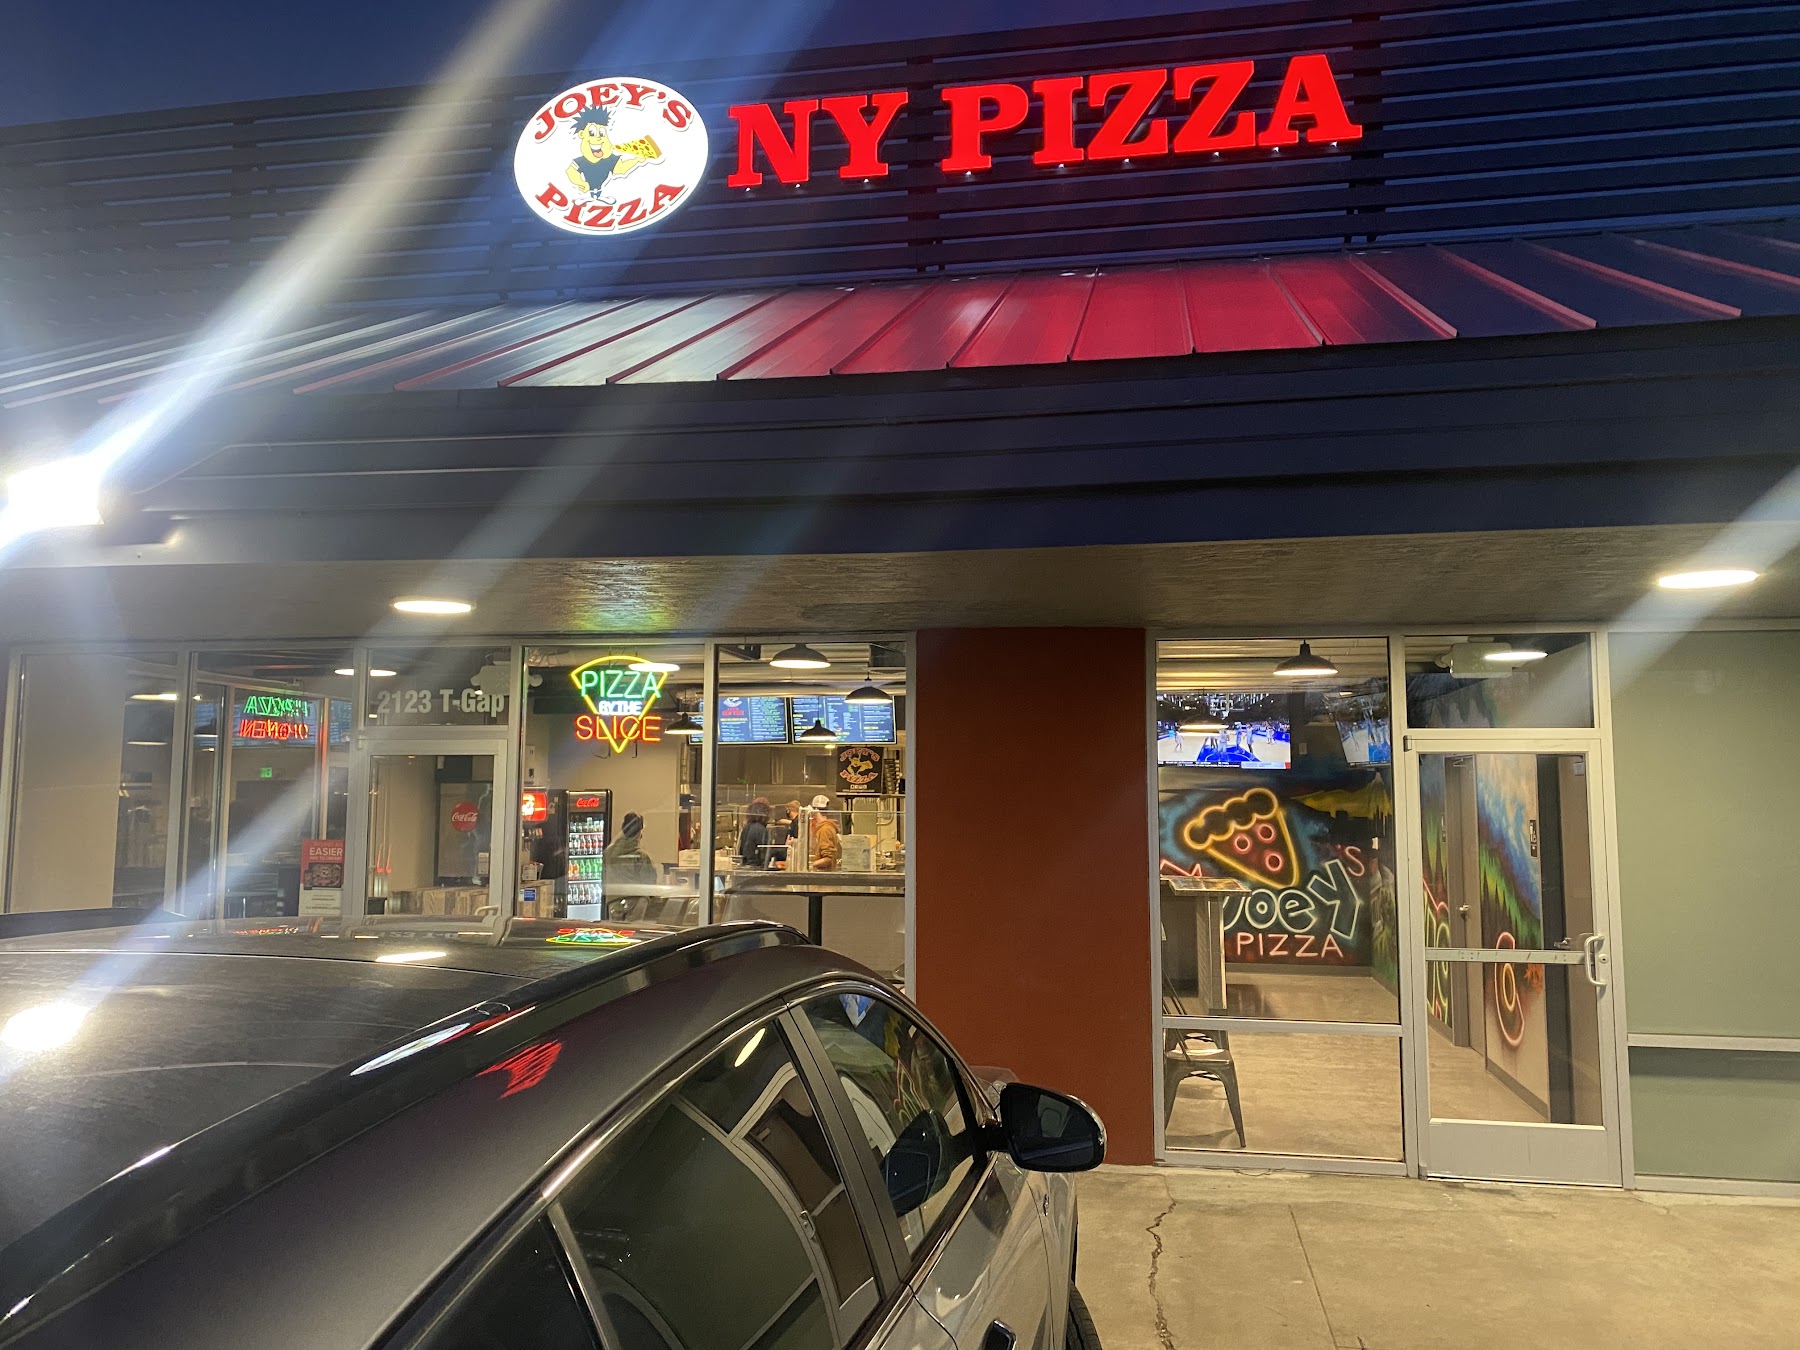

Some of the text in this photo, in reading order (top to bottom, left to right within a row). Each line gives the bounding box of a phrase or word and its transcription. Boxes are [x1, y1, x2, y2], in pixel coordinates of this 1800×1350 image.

[534, 83, 692, 140] JOEY'S
[727, 54, 1362, 187] NY PIZZA
[535, 182, 685, 228] PIZZA
[581, 669, 661, 698] PIZZA
[377, 688, 505, 718] 2123 T-Gap
[576, 715, 661, 741] SLICE
[840, 770, 878, 784] PIZZA
[309, 847, 343, 856] EASIER
[1237, 932, 1344, 958] PIZZA
